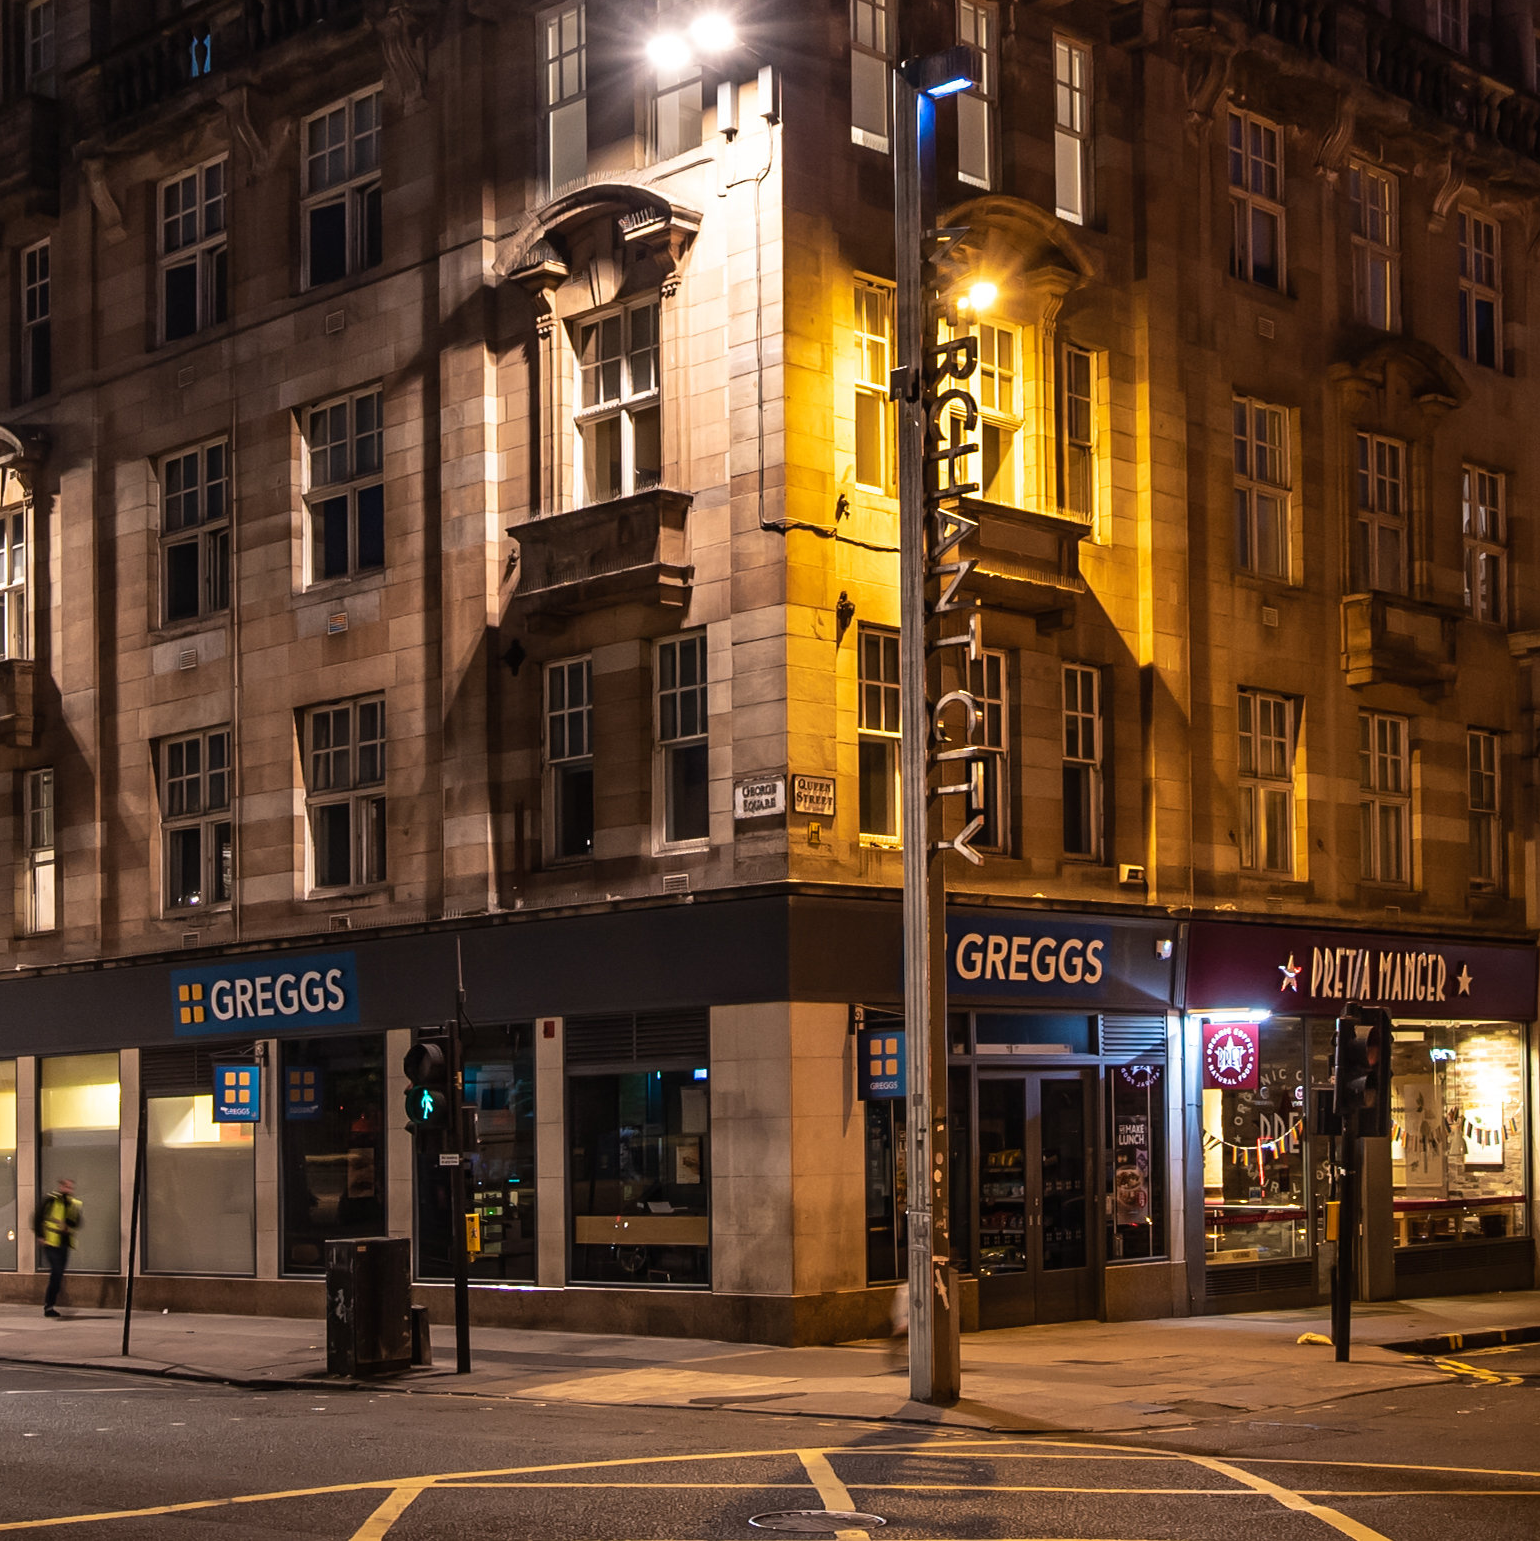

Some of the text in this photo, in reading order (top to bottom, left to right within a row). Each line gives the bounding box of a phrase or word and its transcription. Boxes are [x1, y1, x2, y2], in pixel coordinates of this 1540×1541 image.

[798, 778, 831, 793] QUEEN
[928, 689, 985, 868] CITY
[742, 783, 777, 798] GEORGE
[743, 798, 776, 813] SQUARE
[796, 791, 834, 806] STREET
[955, 933, 1105, 984] GREGGS
[1311, 947, 1357, 999] PRET
[1377, 951, 1447, 1002] MANGER
[211, 968, 345, 1021] GREGGS
[1218, 1046, 1243, 1068] PRET
[1208, 1062, 1253, 1086] NATURAL FOOD
[870, 1081, 899, 1090] GREGGS
[224, 1107, 250, 1116] GREGGS
[1118, 1134, 1145, 1145] LUNCH
